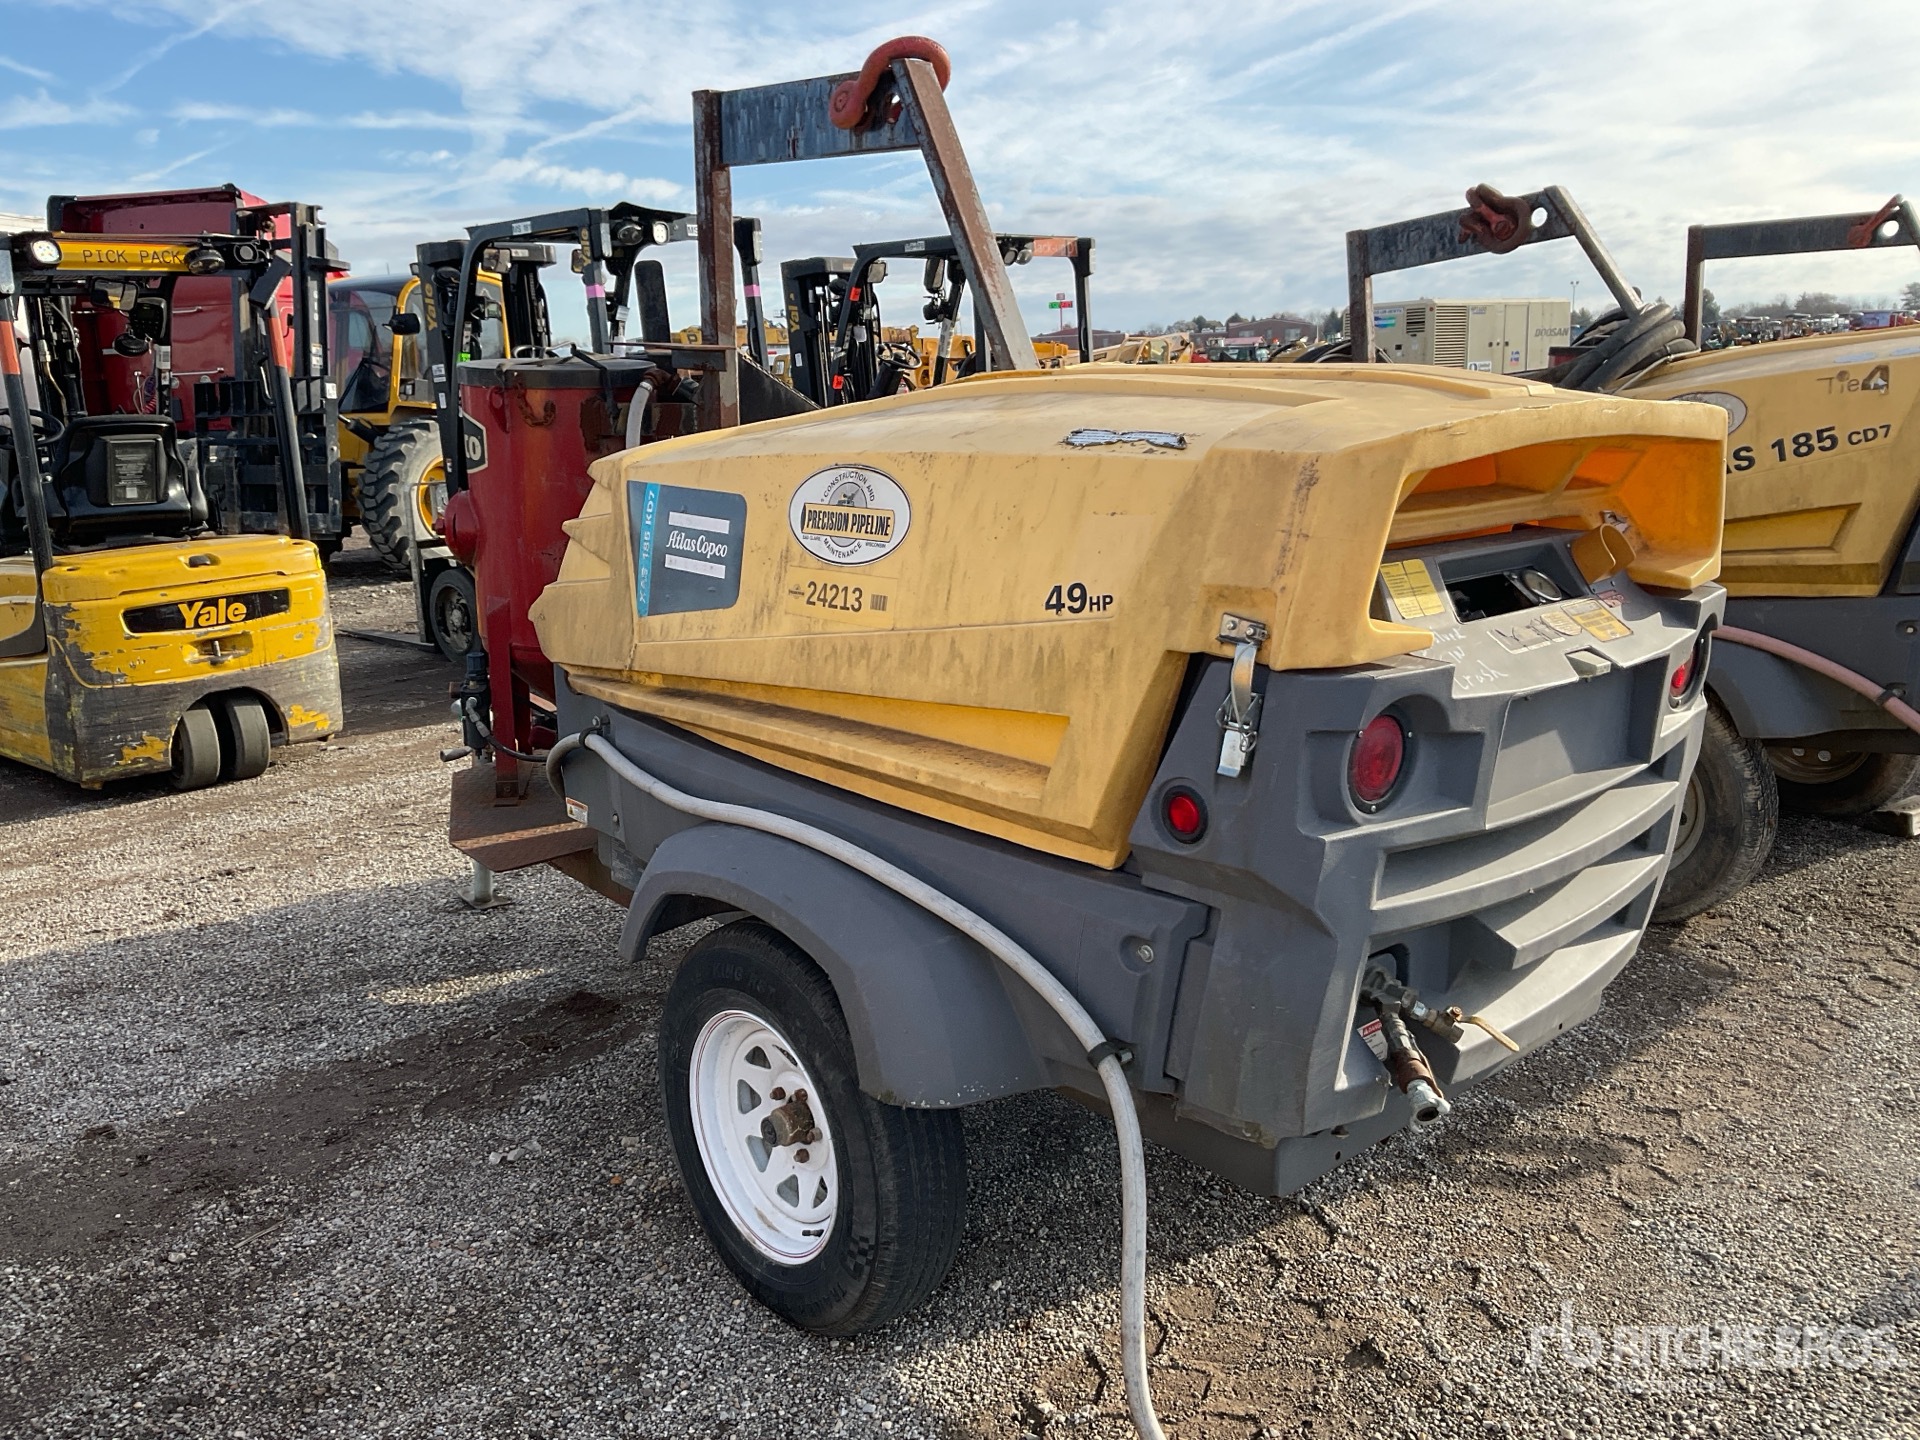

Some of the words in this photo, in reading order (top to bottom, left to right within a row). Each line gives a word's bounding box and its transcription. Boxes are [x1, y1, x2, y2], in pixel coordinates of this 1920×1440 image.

[83, 249, 128, 263] PICK
[138, 249, 184, 264] PACK
[424, 283, 438, 331] Yale
[1534, 327, 1569, 338] DOOSAN
[1771, 425, 1838, 462] 185
[1847, 424, 1892, 446] CD7
[823, 471, 867, 498] CONSTRUCTION
[866, 484, 875, 502] AND
[806, 509, 849, 532] PRECISION
[850, 513, 891, 537] PIPELINE
[639, 567, 648, 603] XAS
[645, 490, 655, 526] KD7
[666, 530, 696, 551] Atlas
[696, 534, 728, 559] Copco
[823, 537, 862, 559] MAINTENANCE
[806, 580, 863, 612] 24213
[177, 598, 248, 629] Yale
